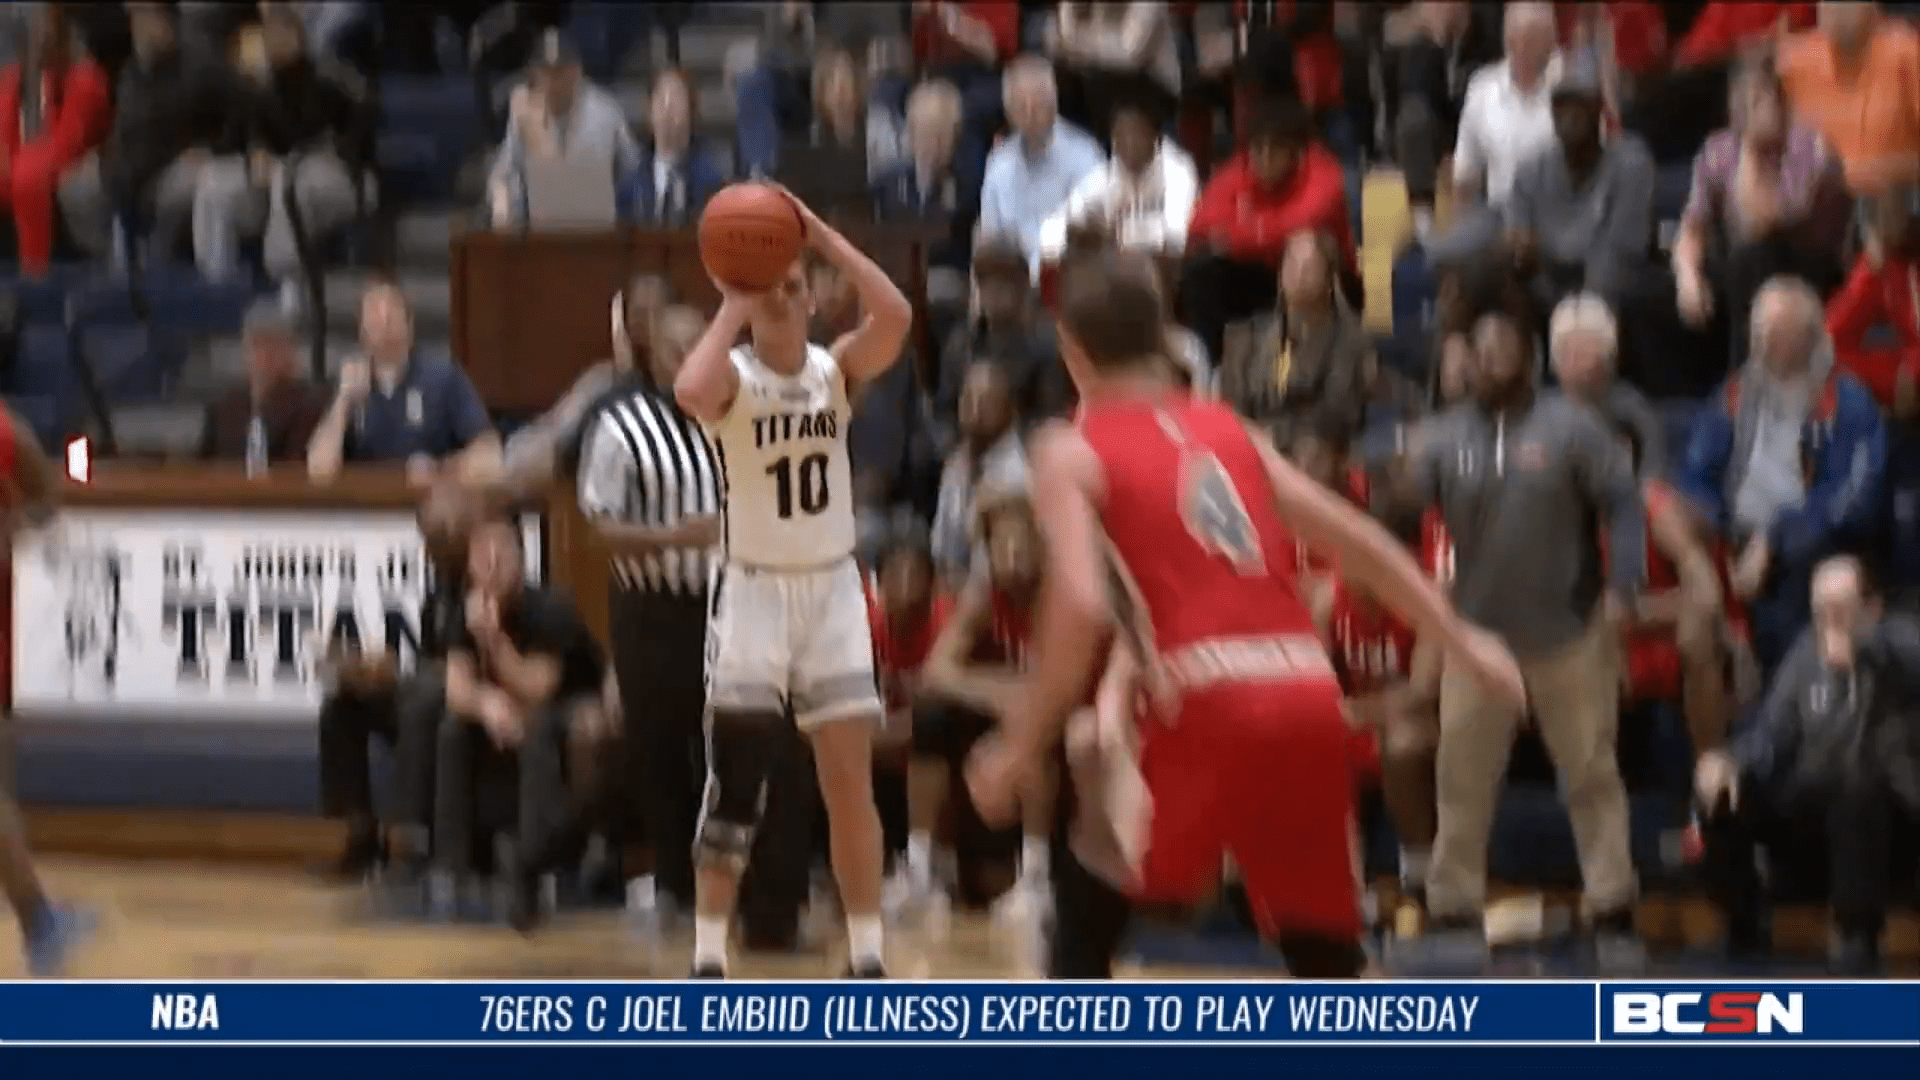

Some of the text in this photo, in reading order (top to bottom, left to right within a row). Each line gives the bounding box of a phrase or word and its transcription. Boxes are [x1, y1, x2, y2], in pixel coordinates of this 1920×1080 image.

[751, 410, 837, 449] TITANS
[765, 453, 829, 519] 10
[1177, 449, 1269, 578] 4
